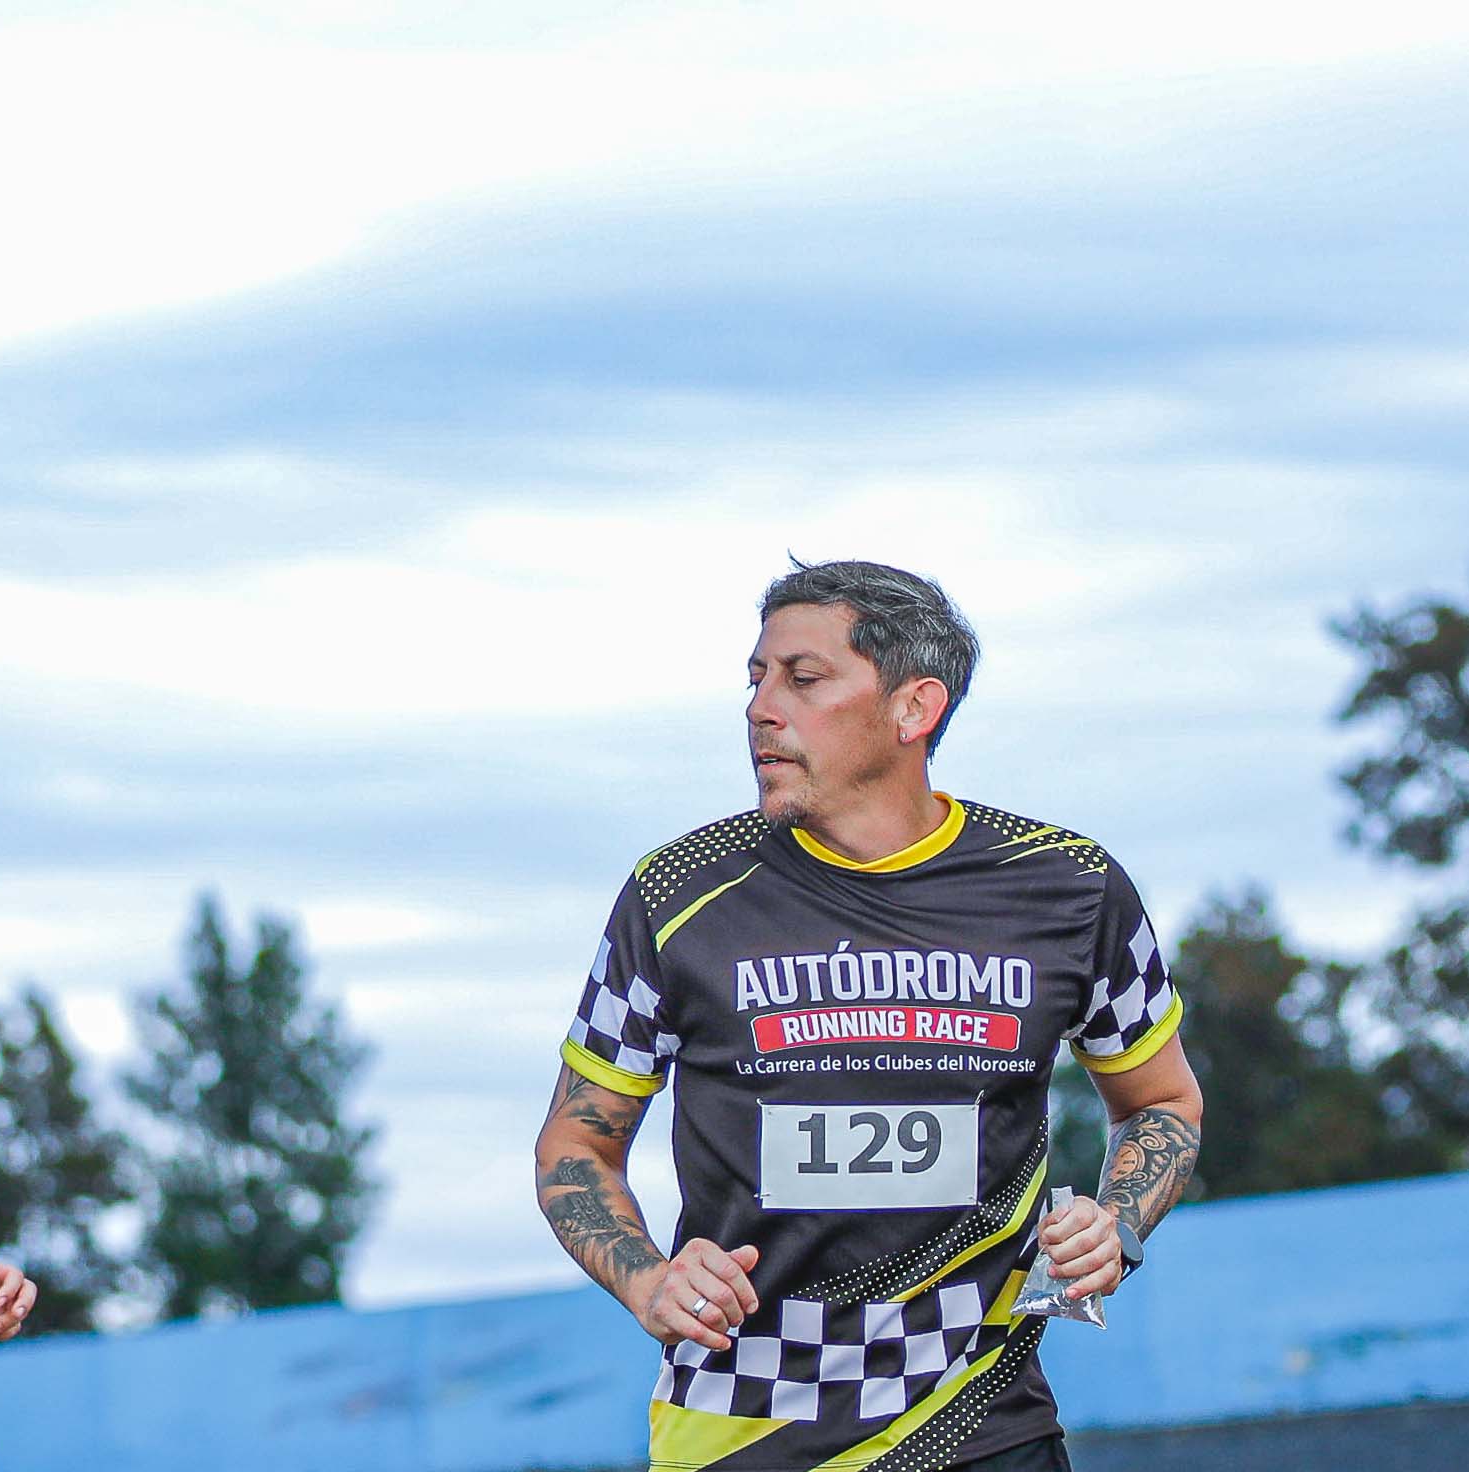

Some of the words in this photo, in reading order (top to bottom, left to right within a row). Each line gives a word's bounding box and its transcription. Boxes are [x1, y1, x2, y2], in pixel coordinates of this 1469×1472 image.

[735, 940, 1032, 1013] AUTÓDROMO
[781, 1010, 907, 1045] RUNNING
[914, 1010, 991, 1045] RACE
[735, 1060, 753, 1075] La
[755, 1058, 816, 1075] Carrera
[820, 1054, 842, 1071] de
[846, 1054, 871, 1071] los
[874, 1054, 933, 1071] Clubes
[937, 1054, 964, 1071] del
[968, 1055, 1036, 1073] Noroeste
[797, 1110, 942, 1174] 129
